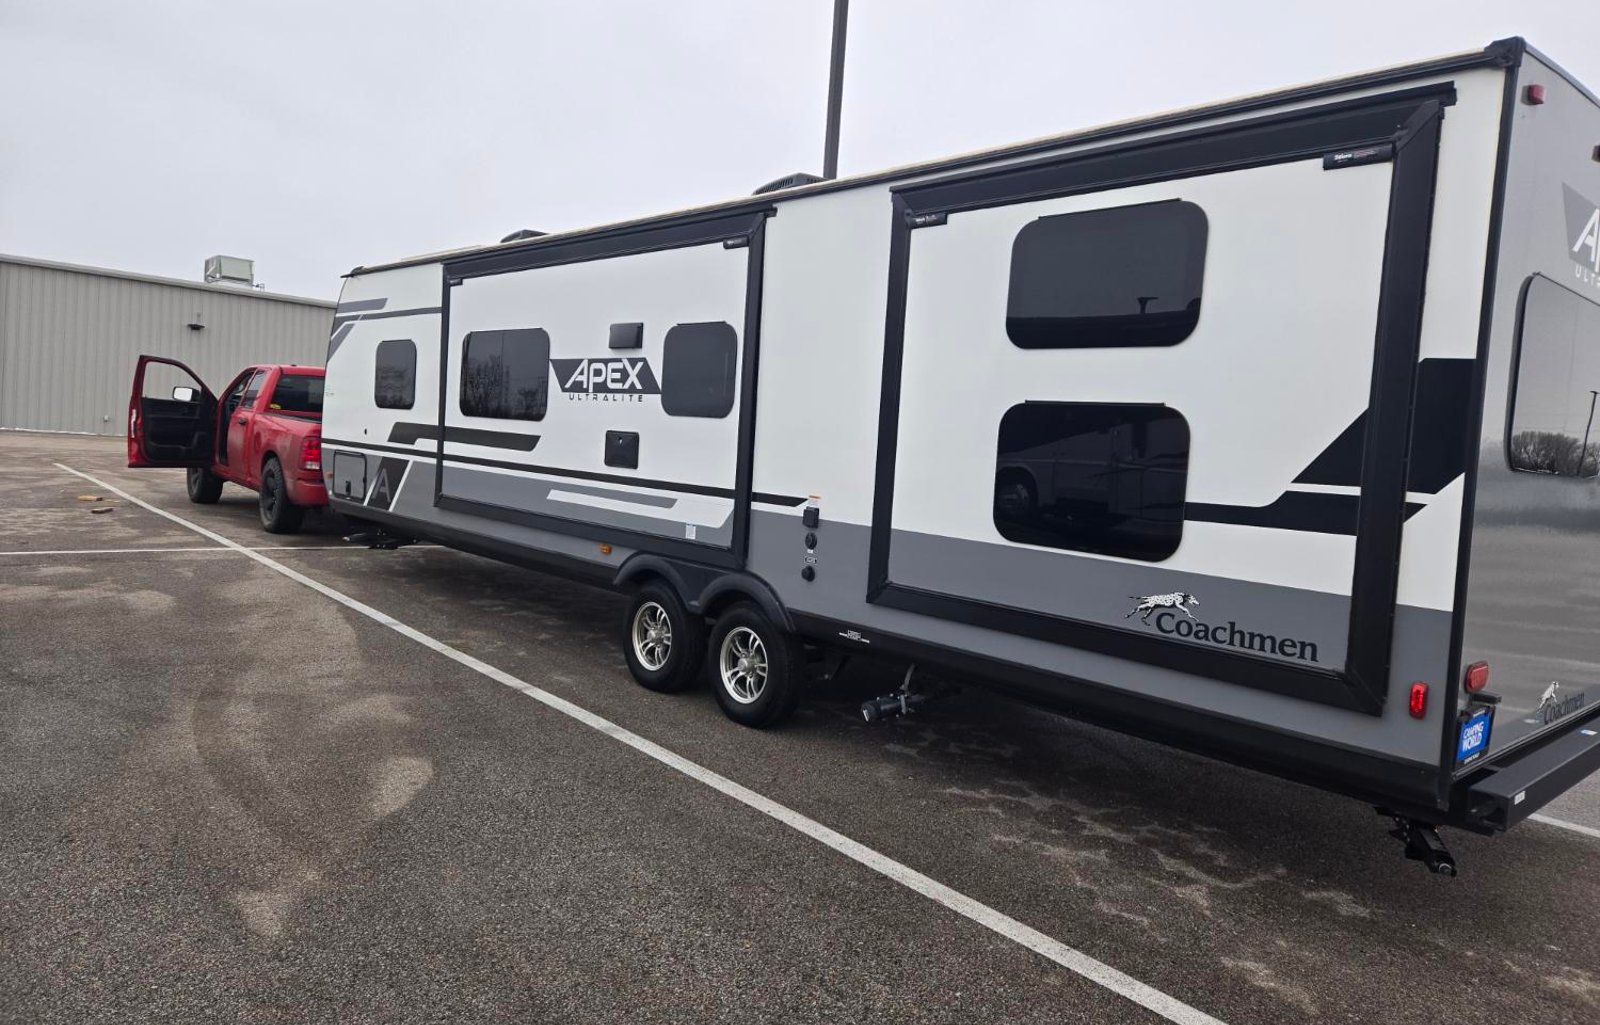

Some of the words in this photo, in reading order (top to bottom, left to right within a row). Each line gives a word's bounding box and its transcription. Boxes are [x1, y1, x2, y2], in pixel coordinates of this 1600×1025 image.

[1572, 208, 1600, 273] A
[564, 358, 644, 393] APEX
[569, 393, 643, 402] ULTRALITE
[1155, 612, 1319, 662] Coachmen
[1462, 732, 1483, 752] WORLD
